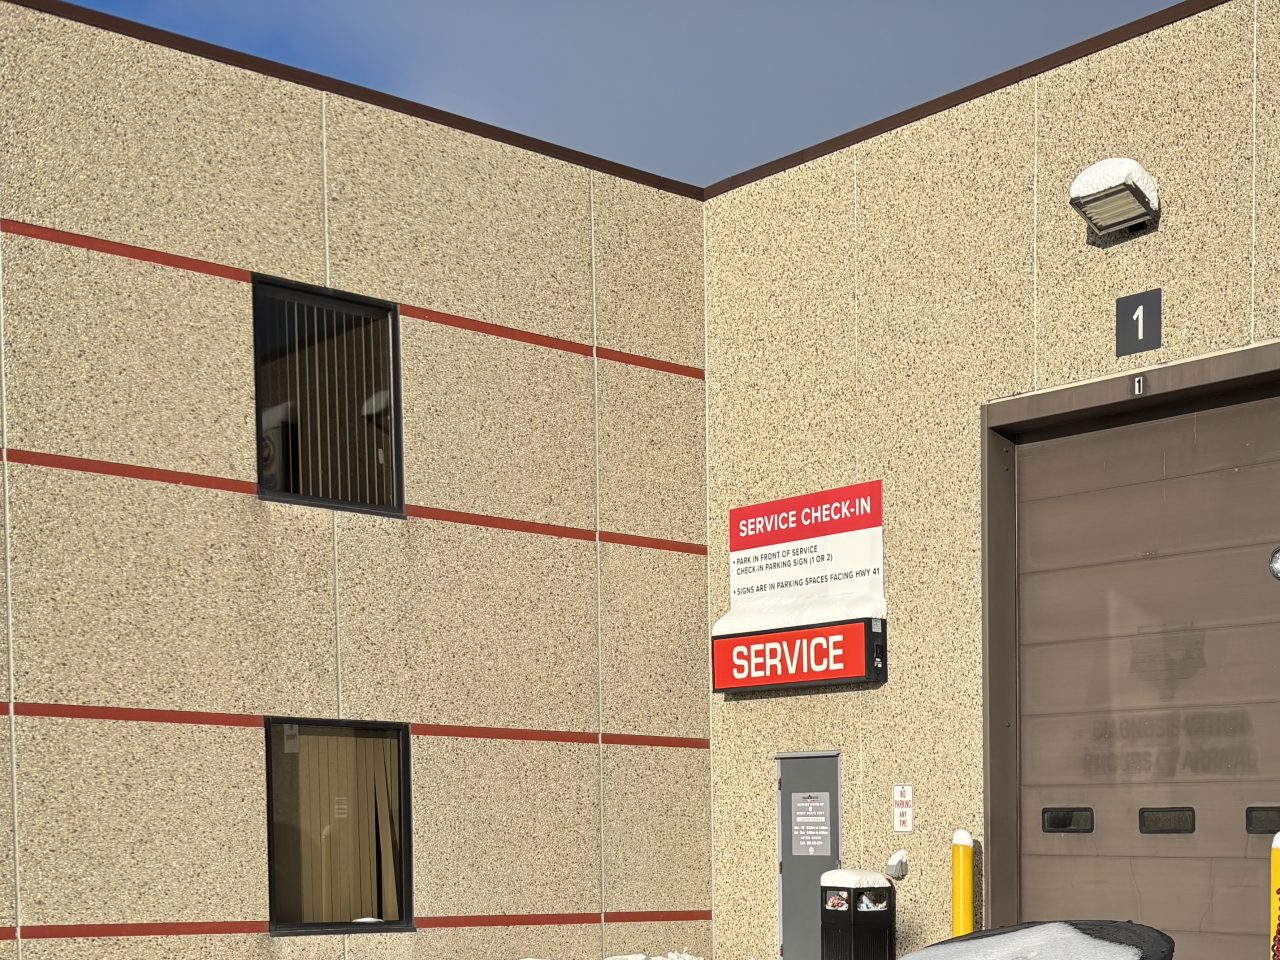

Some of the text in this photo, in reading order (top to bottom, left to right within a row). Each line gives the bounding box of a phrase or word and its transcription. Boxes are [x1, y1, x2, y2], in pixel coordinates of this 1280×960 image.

[1132, 304, 1144, 340] 1
[739, 496, 872, 537] SERVICE CHECK-IN
[736, 545, 818, 566] PARK IN FRONT OF SERVICE
[736, 554, 832, 576] CHECK-IN PARKING SIGN (1 OR 2)
[736, 568, 880, 596] SIGNS ARE IN PARKING SPACES FACING HWY 41
[732, 635, 844, 680] SERVICE
[895, 800, 911, 808] PARKING
[900, 790, 906, 798] NO
